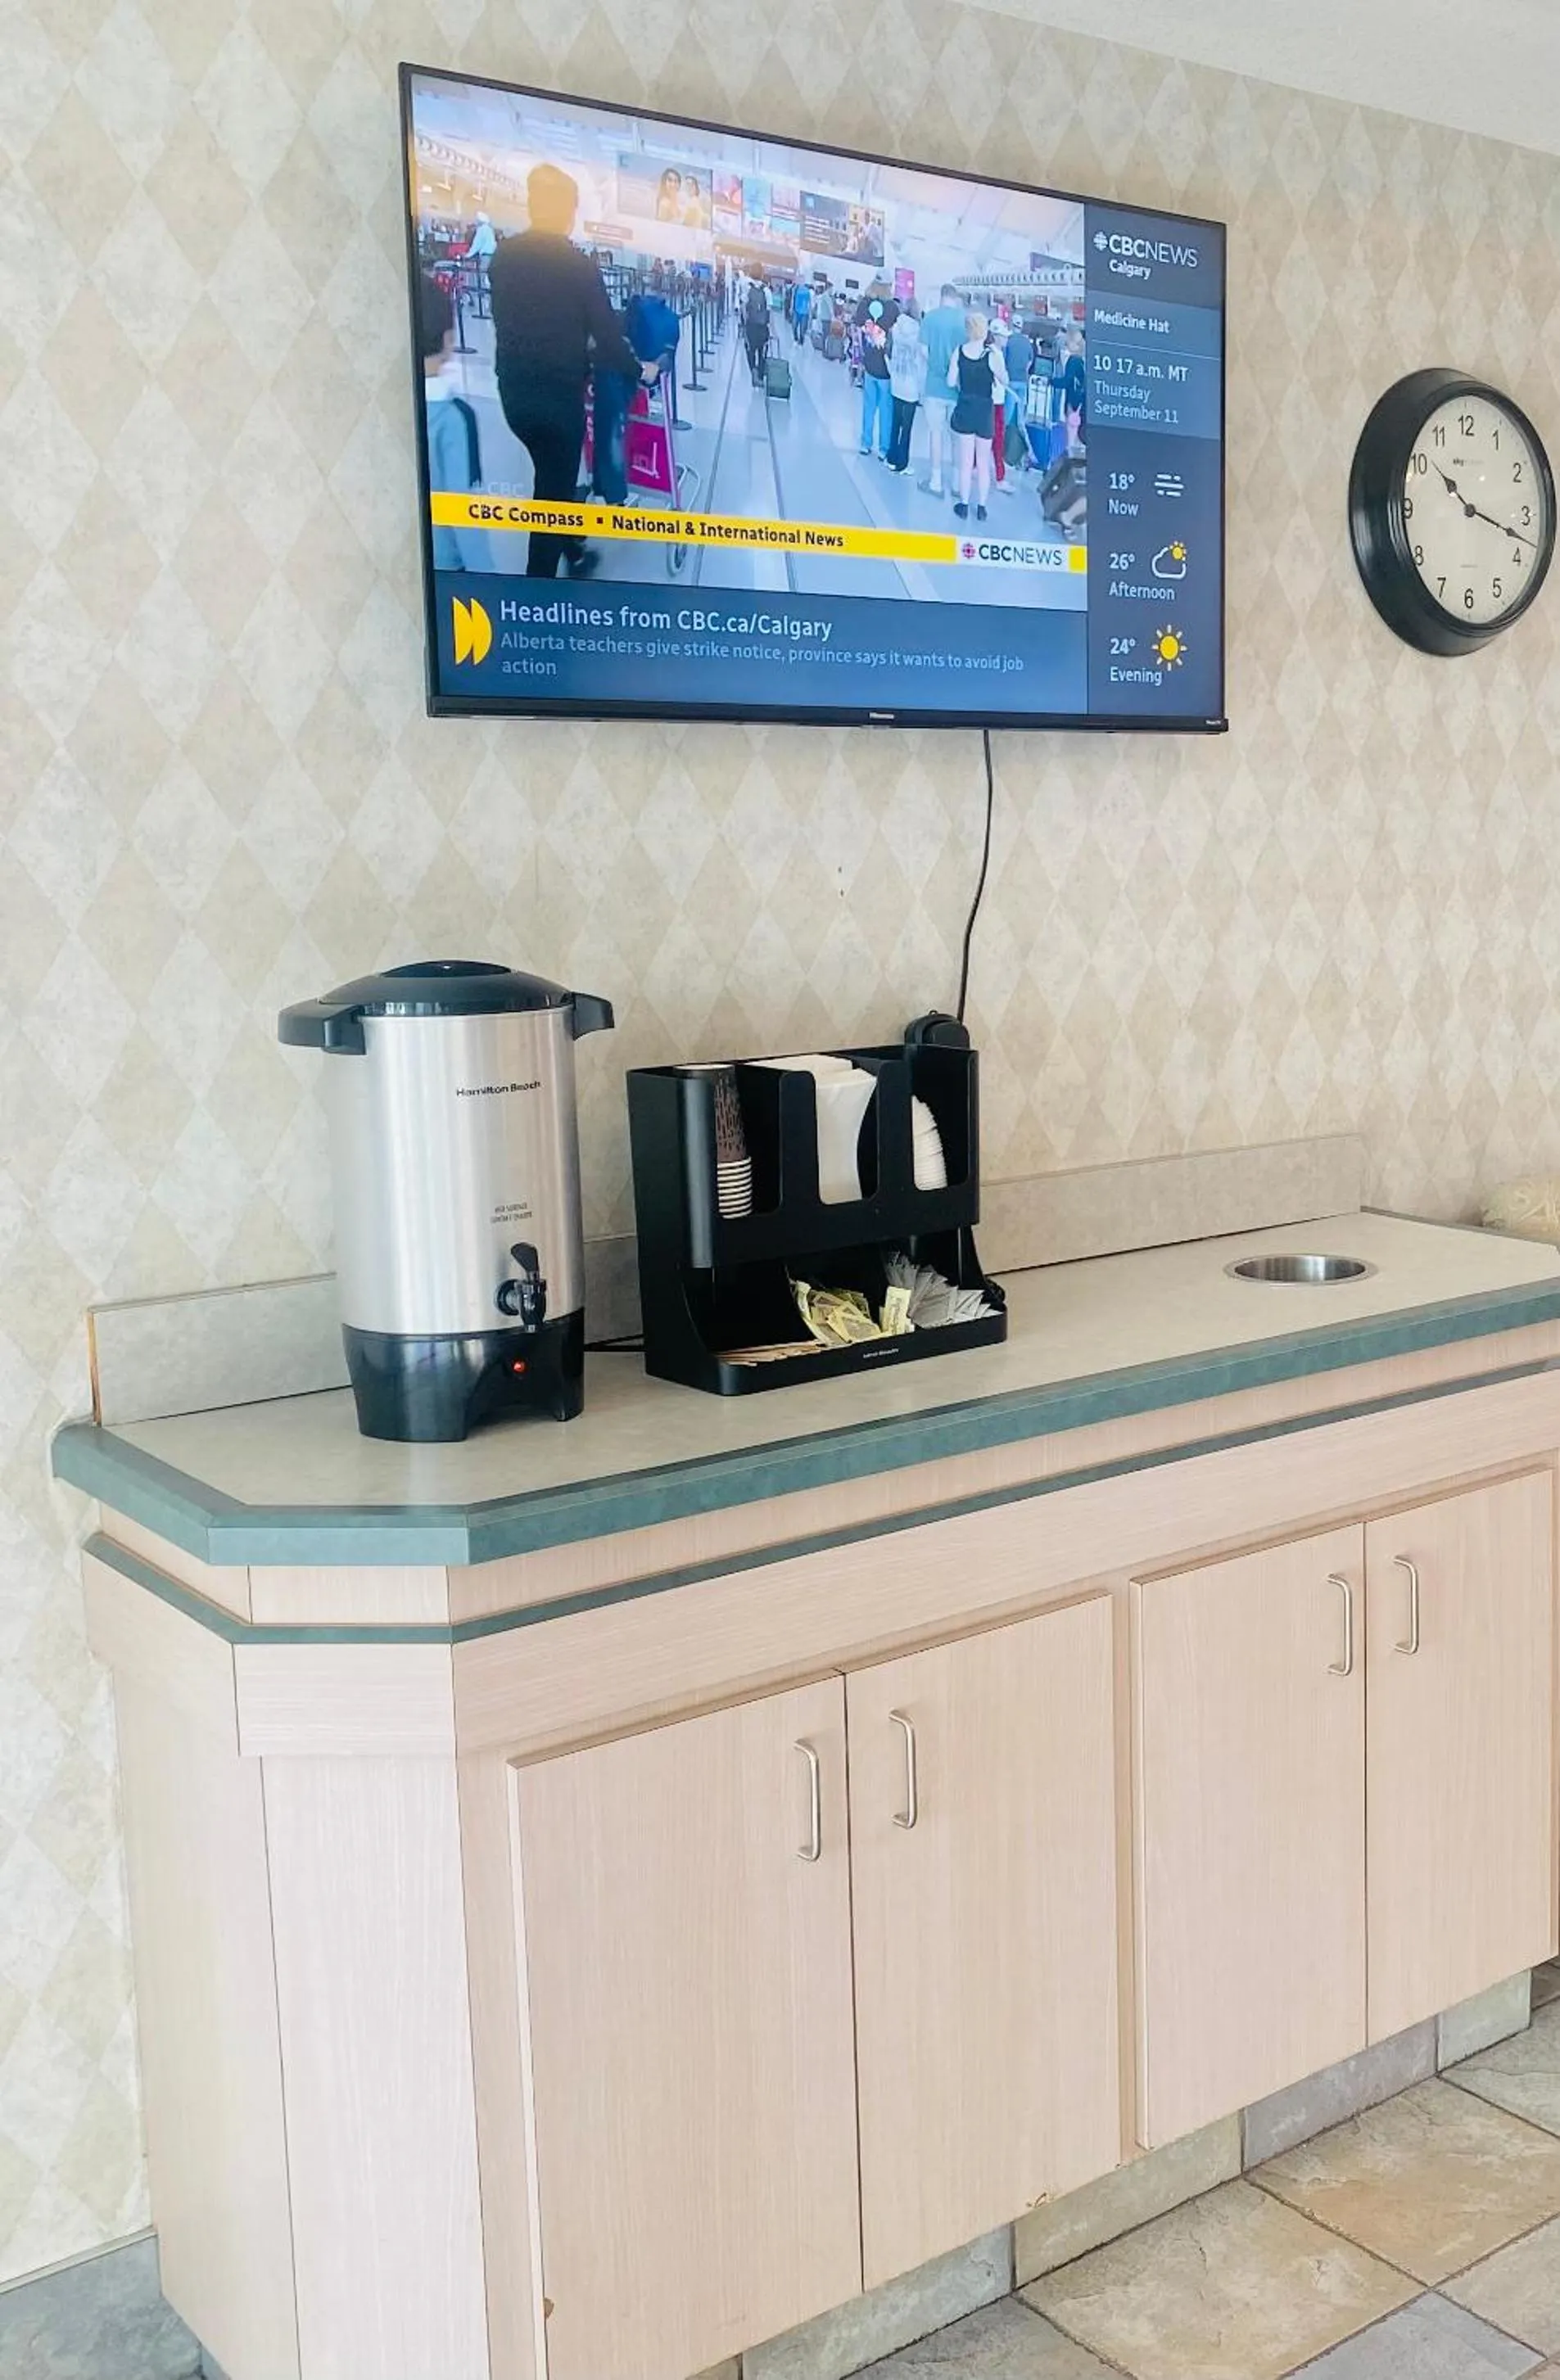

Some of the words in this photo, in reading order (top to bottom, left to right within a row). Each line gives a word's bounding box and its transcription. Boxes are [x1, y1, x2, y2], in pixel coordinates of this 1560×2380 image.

[1109, 260, 1151, 280] Calgary
[1094, 309, 1146, 330] Medicine
[1148, 318, 1169, 334] Hat
[1136, 363, 1164, 380] a.m.
[1169, 366, 1188, 382] MT
[1094, 380, 1150, 403] Thursday
[1094, 400, 1161, 421] September
[1164, 409, 1178, 424] 11
[1458, 415, 1475, 436] 12
[1433, 426, 1445, 447] 11
[1492, 431, 1499, 451] 1
[1411, 453, 1427, 475] 10
[1513, 463, 1522, 483] 2
[1109, 499, 1138, 517] Now
[1403, 498, 1413, 519] 9
[1521, 506, 1531, 526] 3
[468, 504, 504, 521] CBC
[509, 507, 584, 527] Compass
[613, 515, 680, 535] National
[685, 521, 695, 535] &
[700, 522, 800, 544] International
[805, 531, 843, 547] News
[1414, 545, 1424, 566] 8
[1513, 547, 1522, 567] 4
[1109, 581, 1174, 601] Afternoon
[1437, 577, 1447, 599] 7
[1493, 578, 1502, 598] 5
[1464, 589, 1474, 609] 6
[500, 599, 613, 626] Headlines
[620, 606, 670, 629] from
[677, 610, 833, 641] CBC.ca/Calgary
[501, 632, 564, 650] Alberta
[570, 635, 642, 653] teachers
[648, 639, 681, 657] give
[684, 641, 729, 657] strike
[733, 644, 785, 662] notice,
[789, 648, 852, 665] province
[855, 652, 886, 668] says
[889, 651, 900, 665] it
[902, 653, 944, 668] wants
[947, 655, 962, 668] to
[965, 655, 1001, 670] avoid
[1002, 657, 1024, 673] job
[502, 657, 557, 675] action
[1110, 666, 1163, 687] Evening
[456, 1086, 509, 1096] Hamilton
[510, 1080, 540, 1092] Beach
